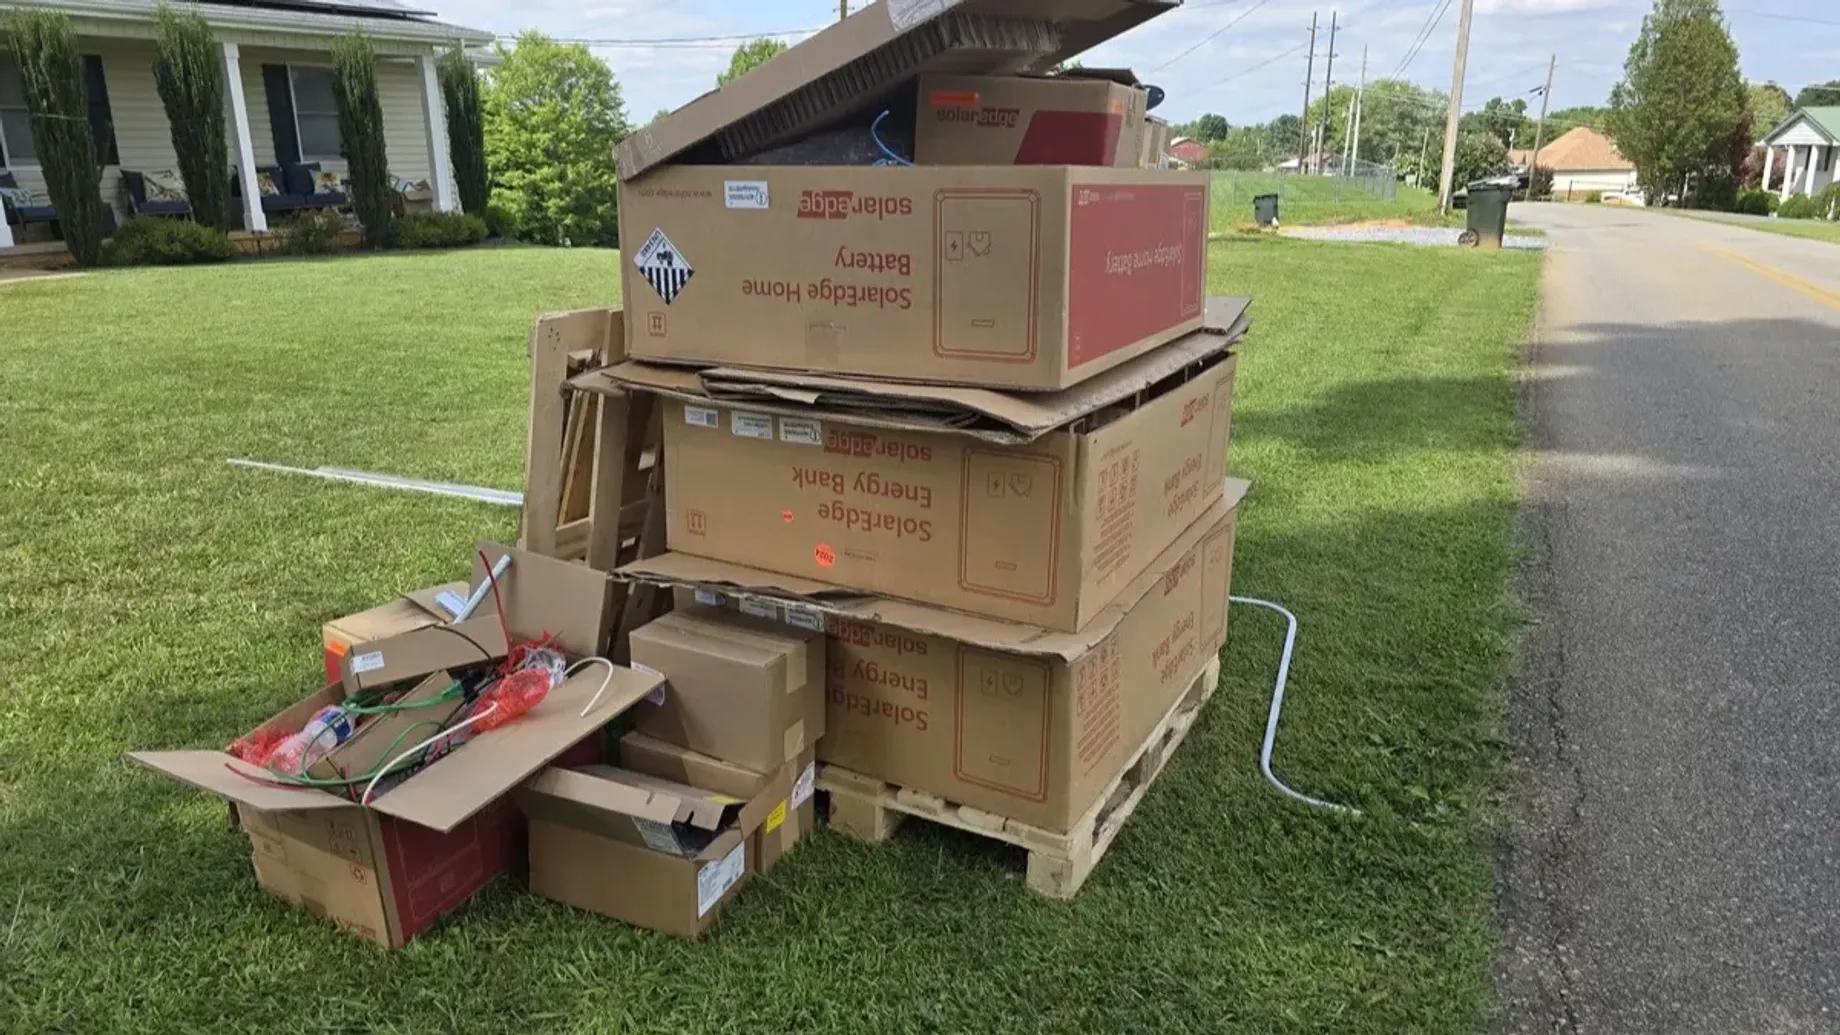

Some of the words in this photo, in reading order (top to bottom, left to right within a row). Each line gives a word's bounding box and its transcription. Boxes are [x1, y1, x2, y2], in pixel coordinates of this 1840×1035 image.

[936, 107, 1020, 128] solaredge
[797, 190, 913, 220] solaredge
[834, 245, 911, 276] Battery
[742, 279, 801, 304] Home
[807, 278, 912, 310] SolarEdge
[824, 429, 932, 463] solaredge
[792, 466, 845, 495] Bank
[853, 471, 932, 509] Energy
[817, 500, 932, 542] SolarEdge
[815, 548, 834, 564] 2024
[851, 659, 928, 700] Energy
